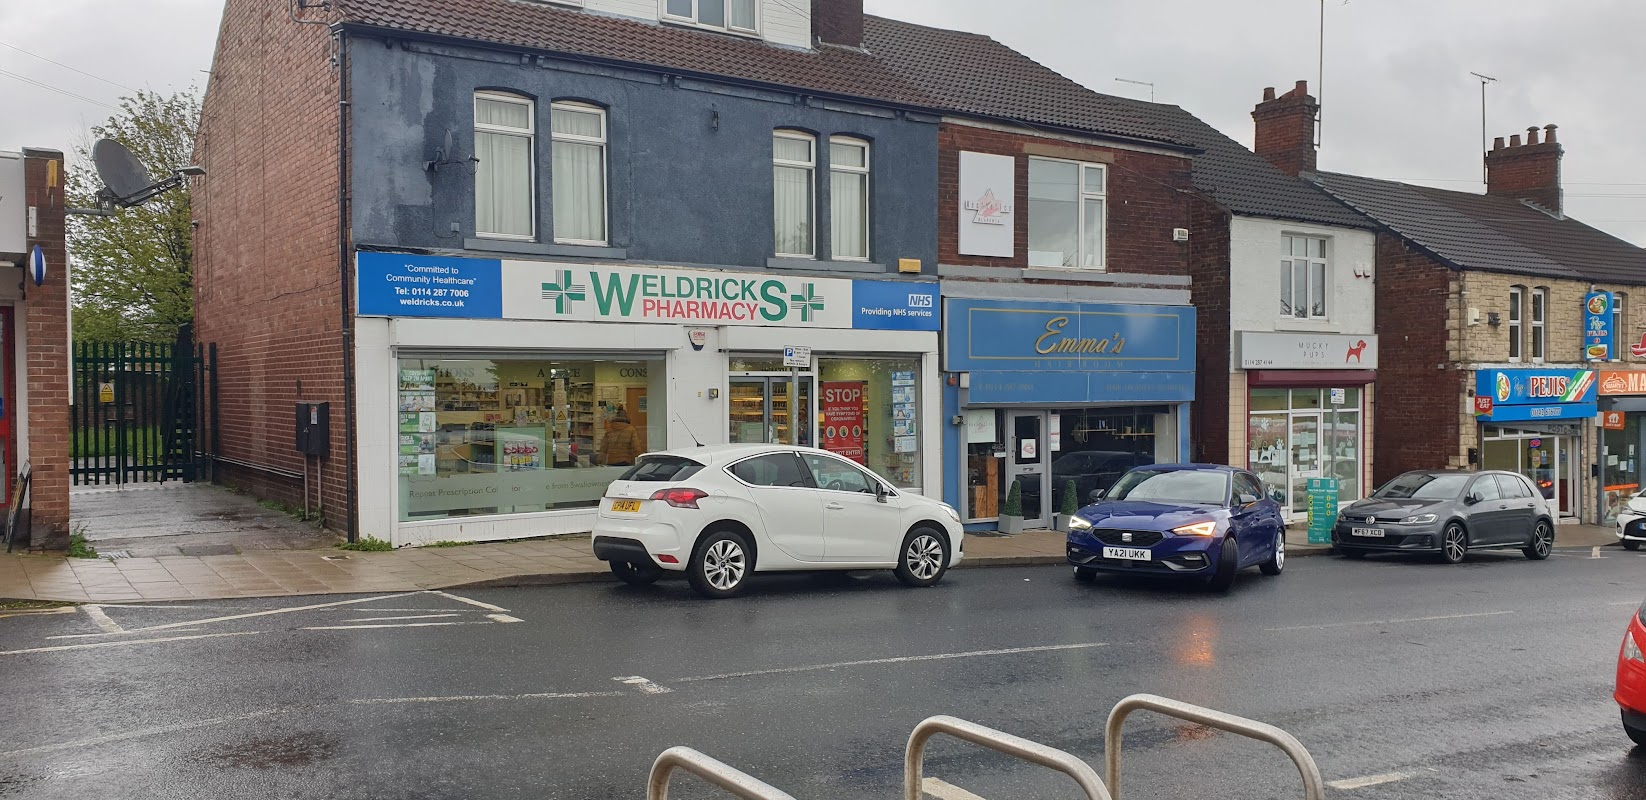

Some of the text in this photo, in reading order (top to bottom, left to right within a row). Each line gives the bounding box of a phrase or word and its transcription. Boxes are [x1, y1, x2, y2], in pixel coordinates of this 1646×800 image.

[451, 267, 459, 275] to
[385, 273, 431, 284] Community
[394, 286, 470, 298] Tel: 0114 287 7006
[589, 271, 788, 322] WELDRICKS
[400, 298, 464, 307] weldricks.co.uk
[909, 295, 932, 306] NHS
[642, 299, 758, 320] PHARMACY
[861, 308, 932, 318] Providing NHS services
[1035, 316, 1127, 354] Emma's
[1530, 376, 1566, 397] PEJIS
[826, 388, 860, 402] STOP
[409, 490, 436, 498] Repeat
[438, 488, 484, 496] Prescription
[1108, 548, 1145, 558] YA21 UKK
